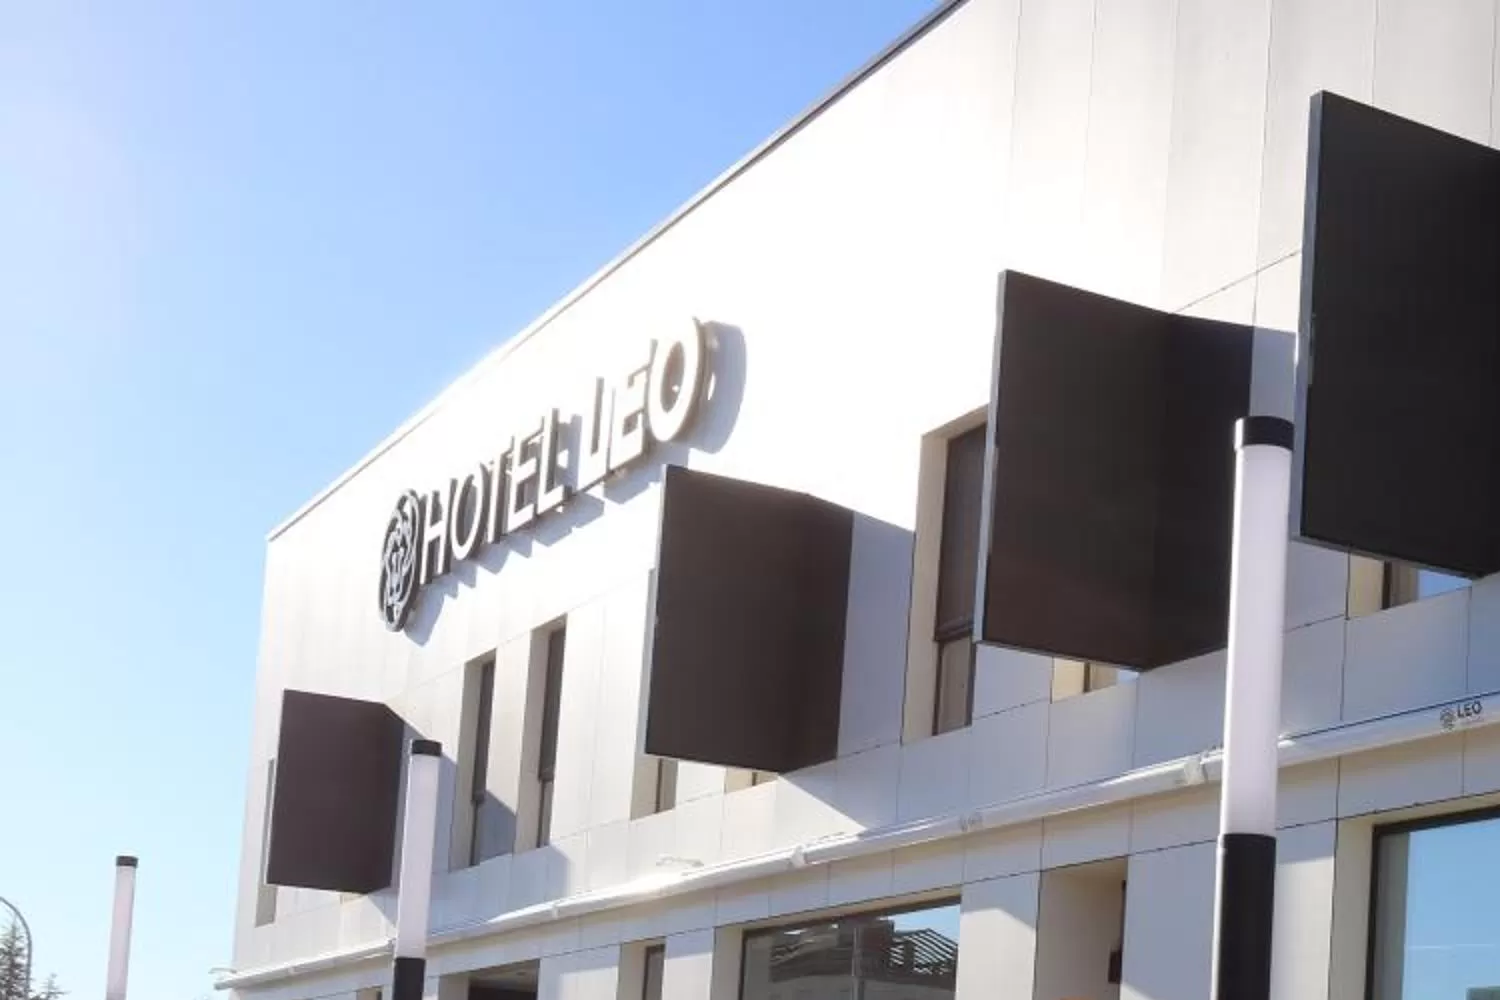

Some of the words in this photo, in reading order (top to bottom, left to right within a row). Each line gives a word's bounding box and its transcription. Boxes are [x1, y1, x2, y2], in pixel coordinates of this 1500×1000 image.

[419, 407, 565, 585] HOTEL
[576, 317, 706, 491] LEO
[1457, 700, 1483, 718] LEO
